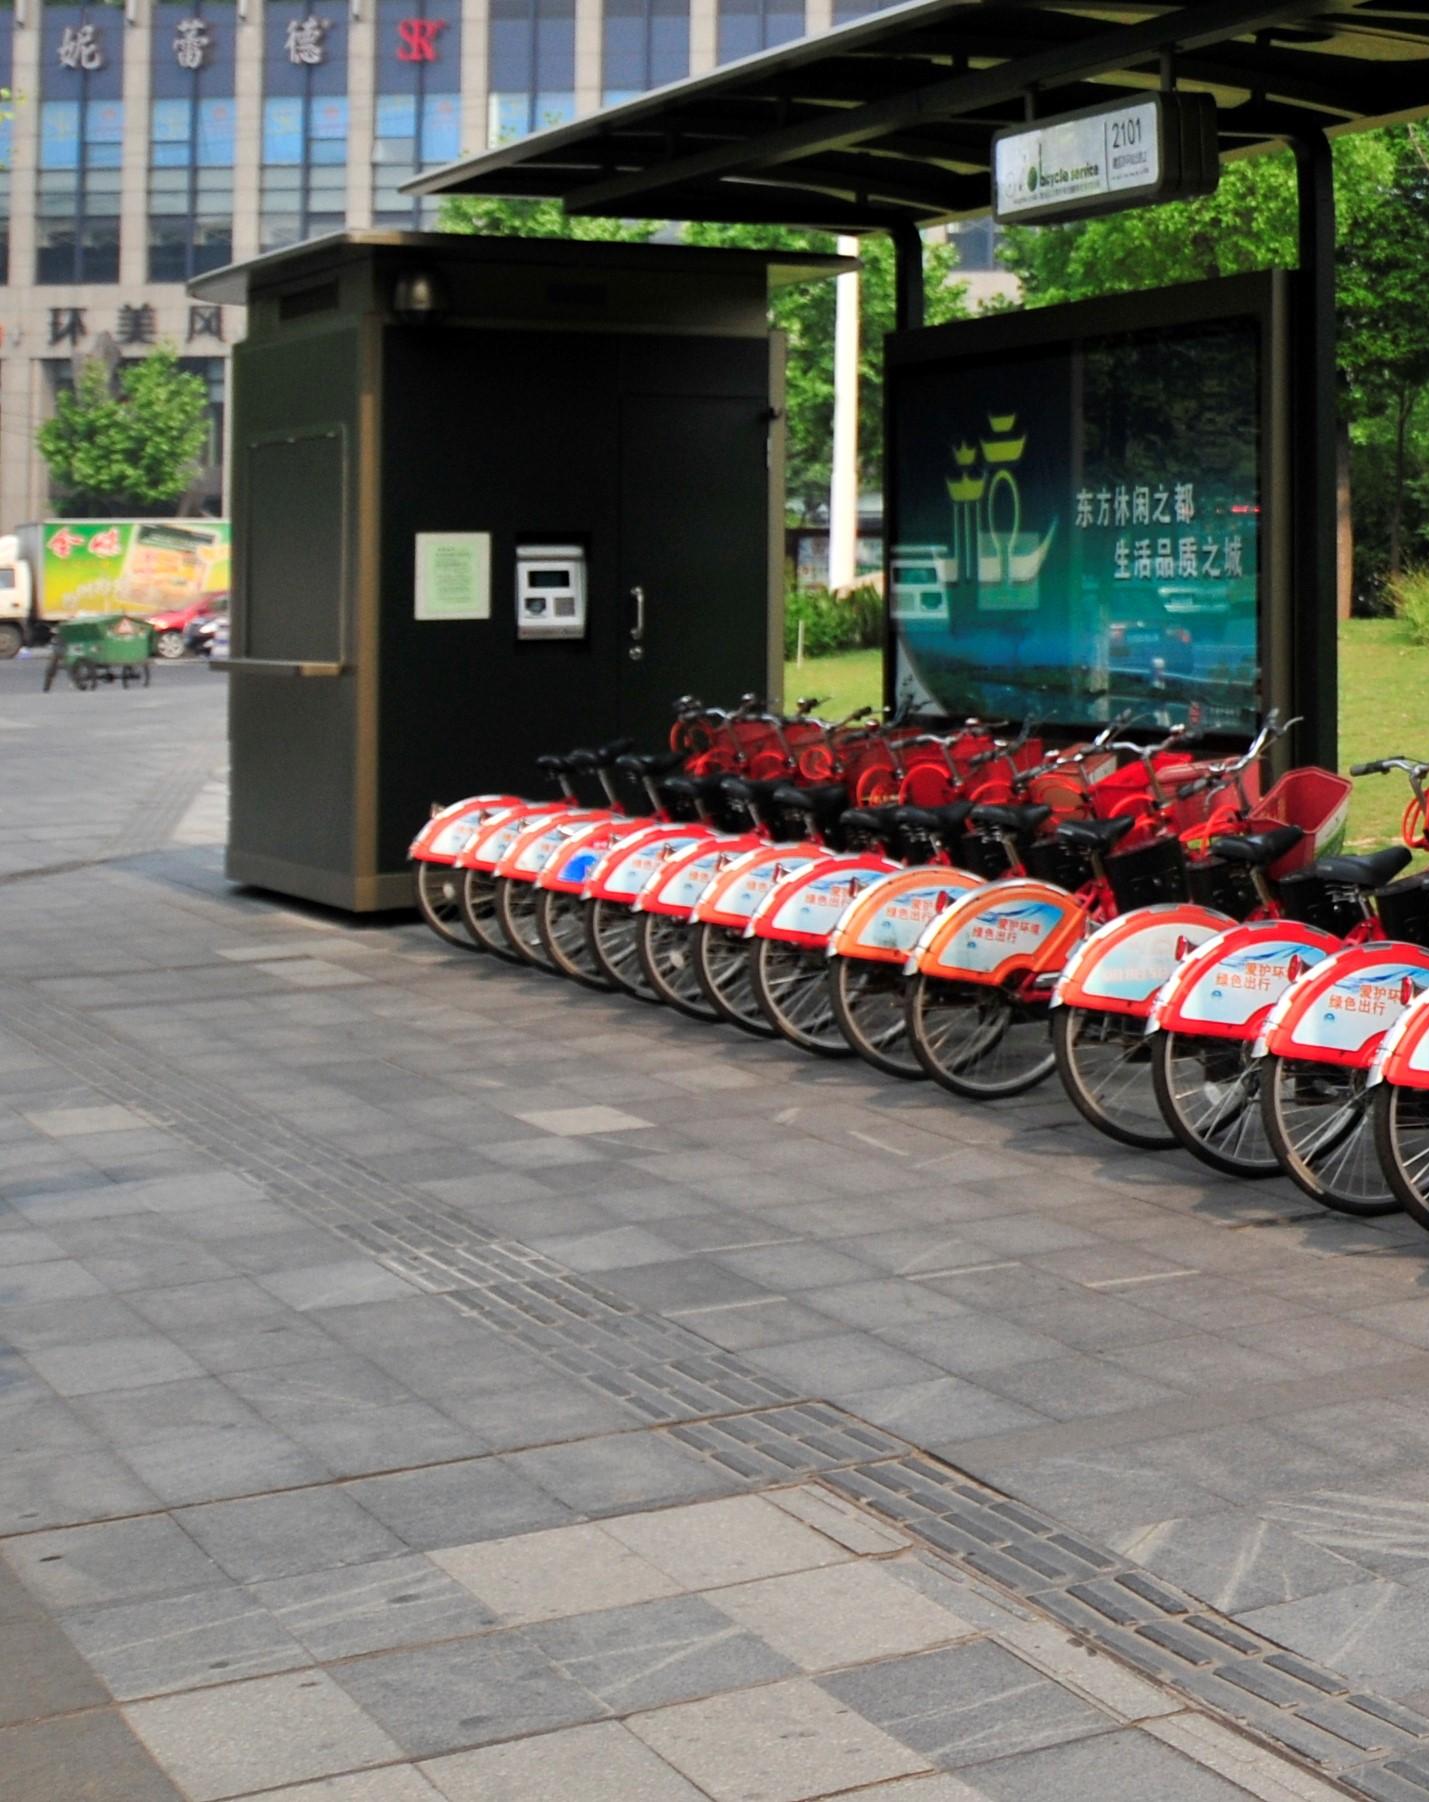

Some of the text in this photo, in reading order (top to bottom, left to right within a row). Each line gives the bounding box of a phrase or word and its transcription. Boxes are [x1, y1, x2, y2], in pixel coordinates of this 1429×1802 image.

[1111, 116, 1142, 149] 2101
[1075, 483, 1195, 529] 东方休闲之都
[1113, 535, 1244, 580] 生活品质之城
[1244, 961, 1289, 977] 爱护环
[1215, 973, 1272, 991] 绿色出行
[1359, 984, 1402, 1003] 爱护环
[1328, 994, 1387, 1016] 绿色出行
